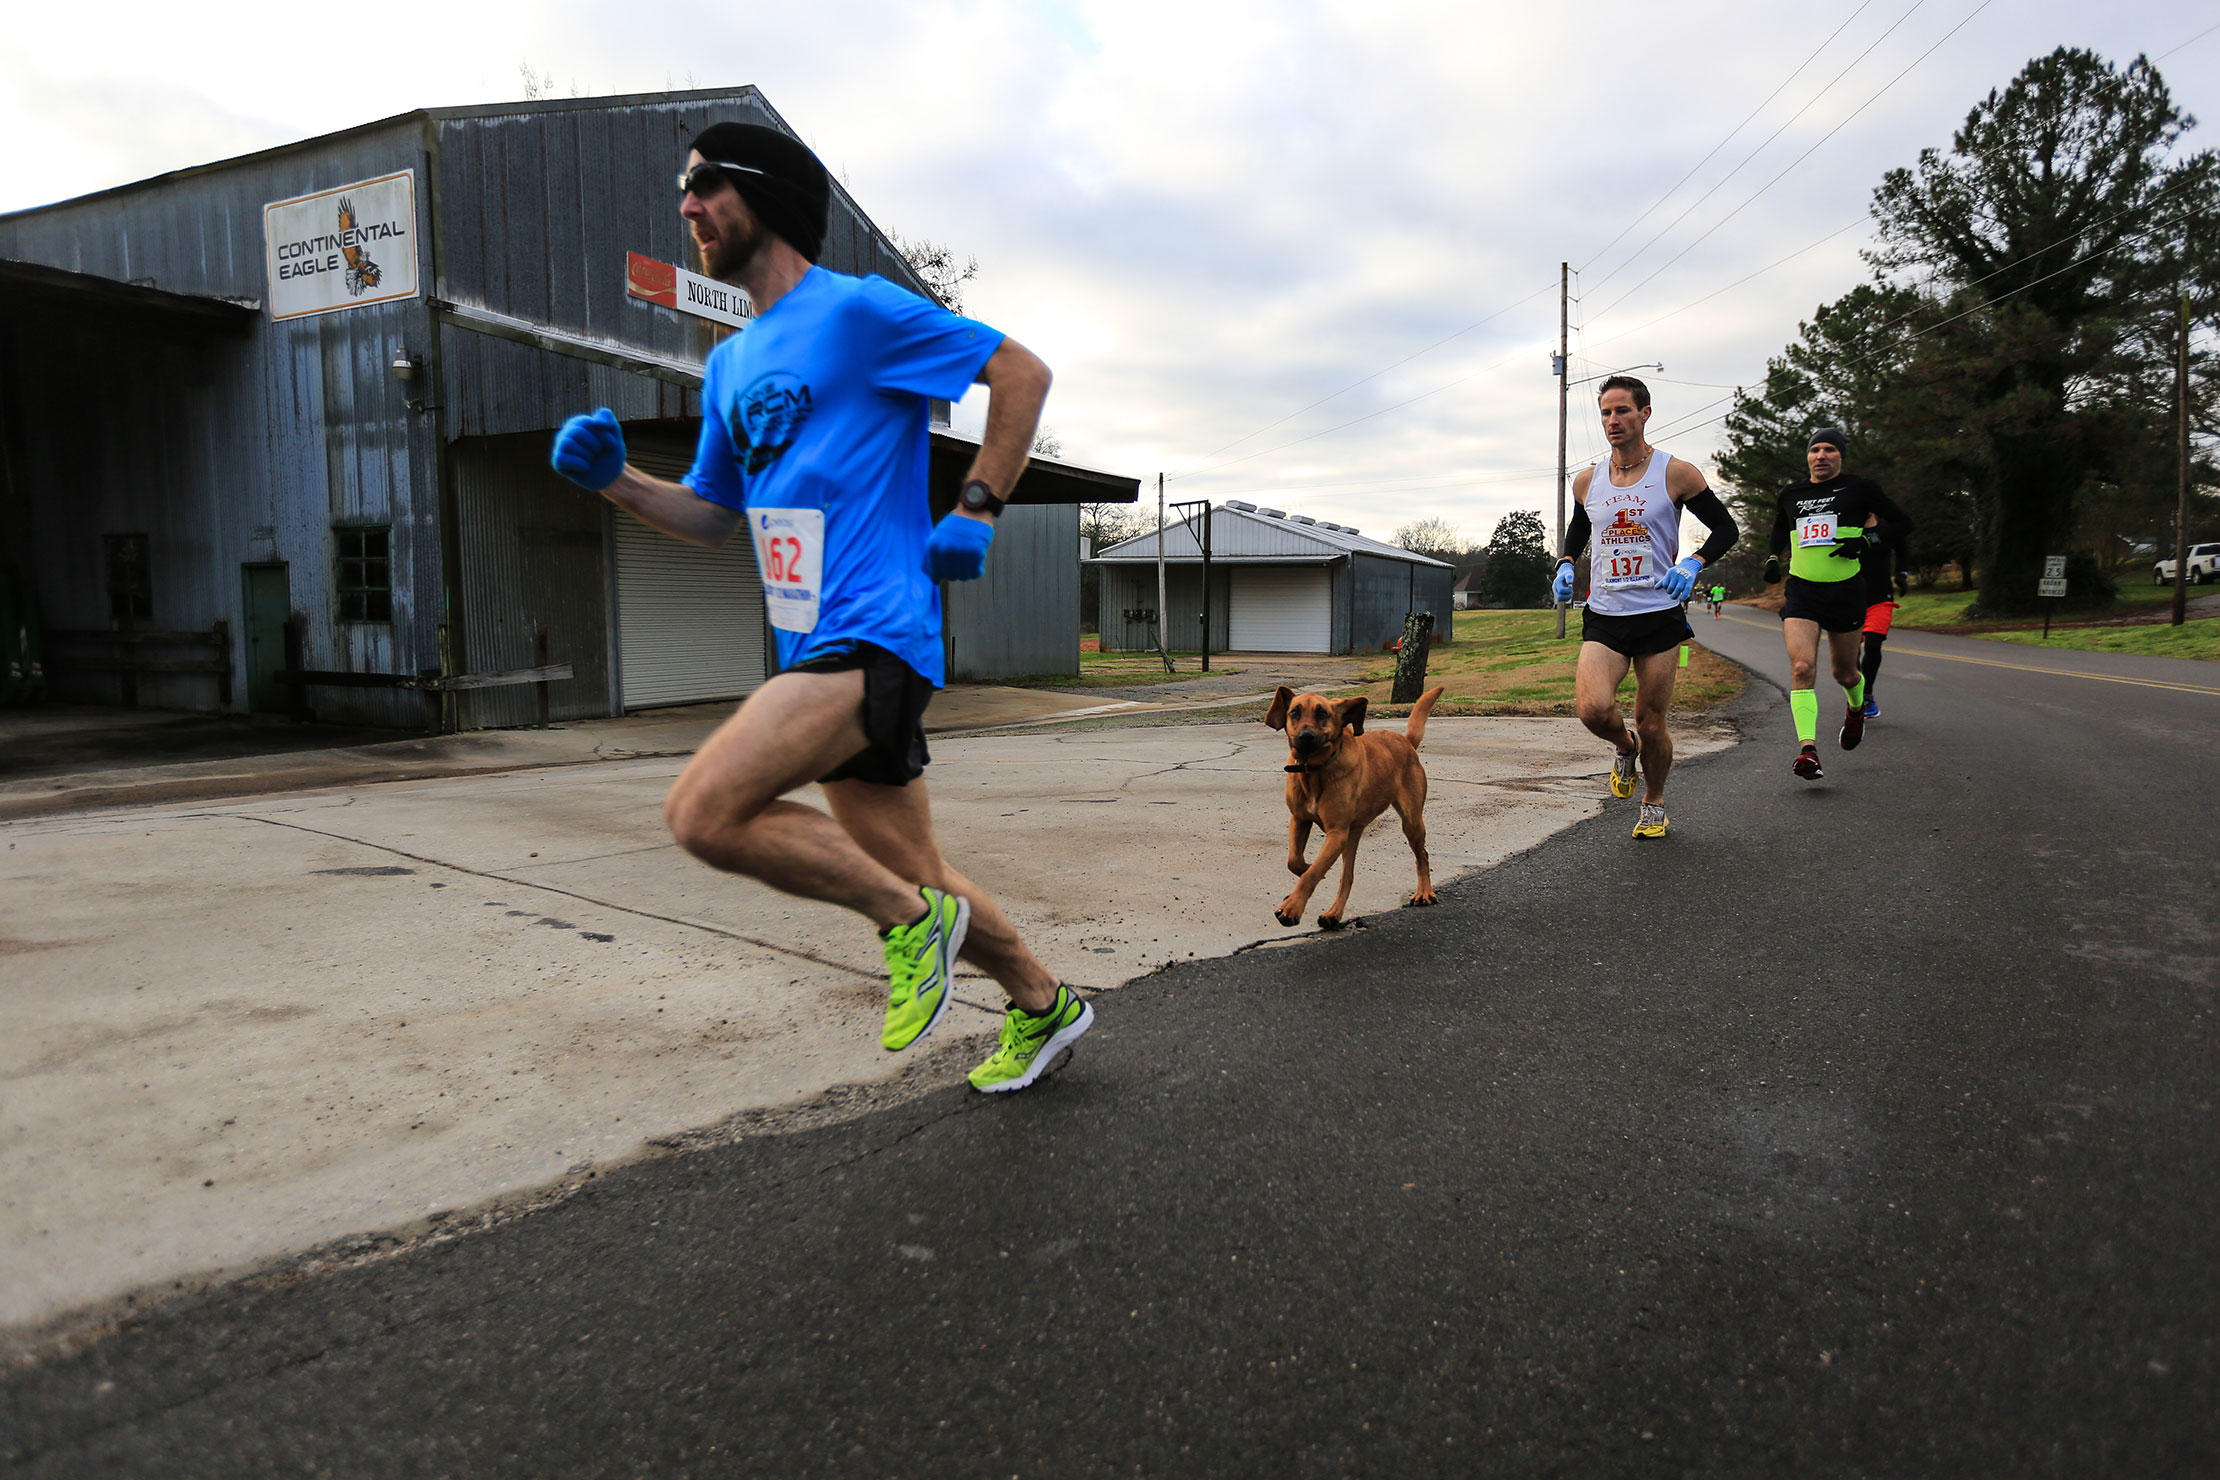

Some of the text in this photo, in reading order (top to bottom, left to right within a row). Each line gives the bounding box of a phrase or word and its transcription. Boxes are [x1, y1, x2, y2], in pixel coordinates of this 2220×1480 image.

[278, 221, 405, 260] CONTINENTAL
[279, 254, 340, 281] EAGLE
[687, 280, 728, 313] NORTH
[1602, 494, 1648, 508] TEAM
[1601, 534, 1652, 545] ATHLETICS
[1608, 528, 1637, 536] PLACE
[1803, 523, 1830, 540] 158
[760, 535, 803, 584] 162
[1610, 555, 1644, 577] 137
[2047, 567, 2061, 576] 25
